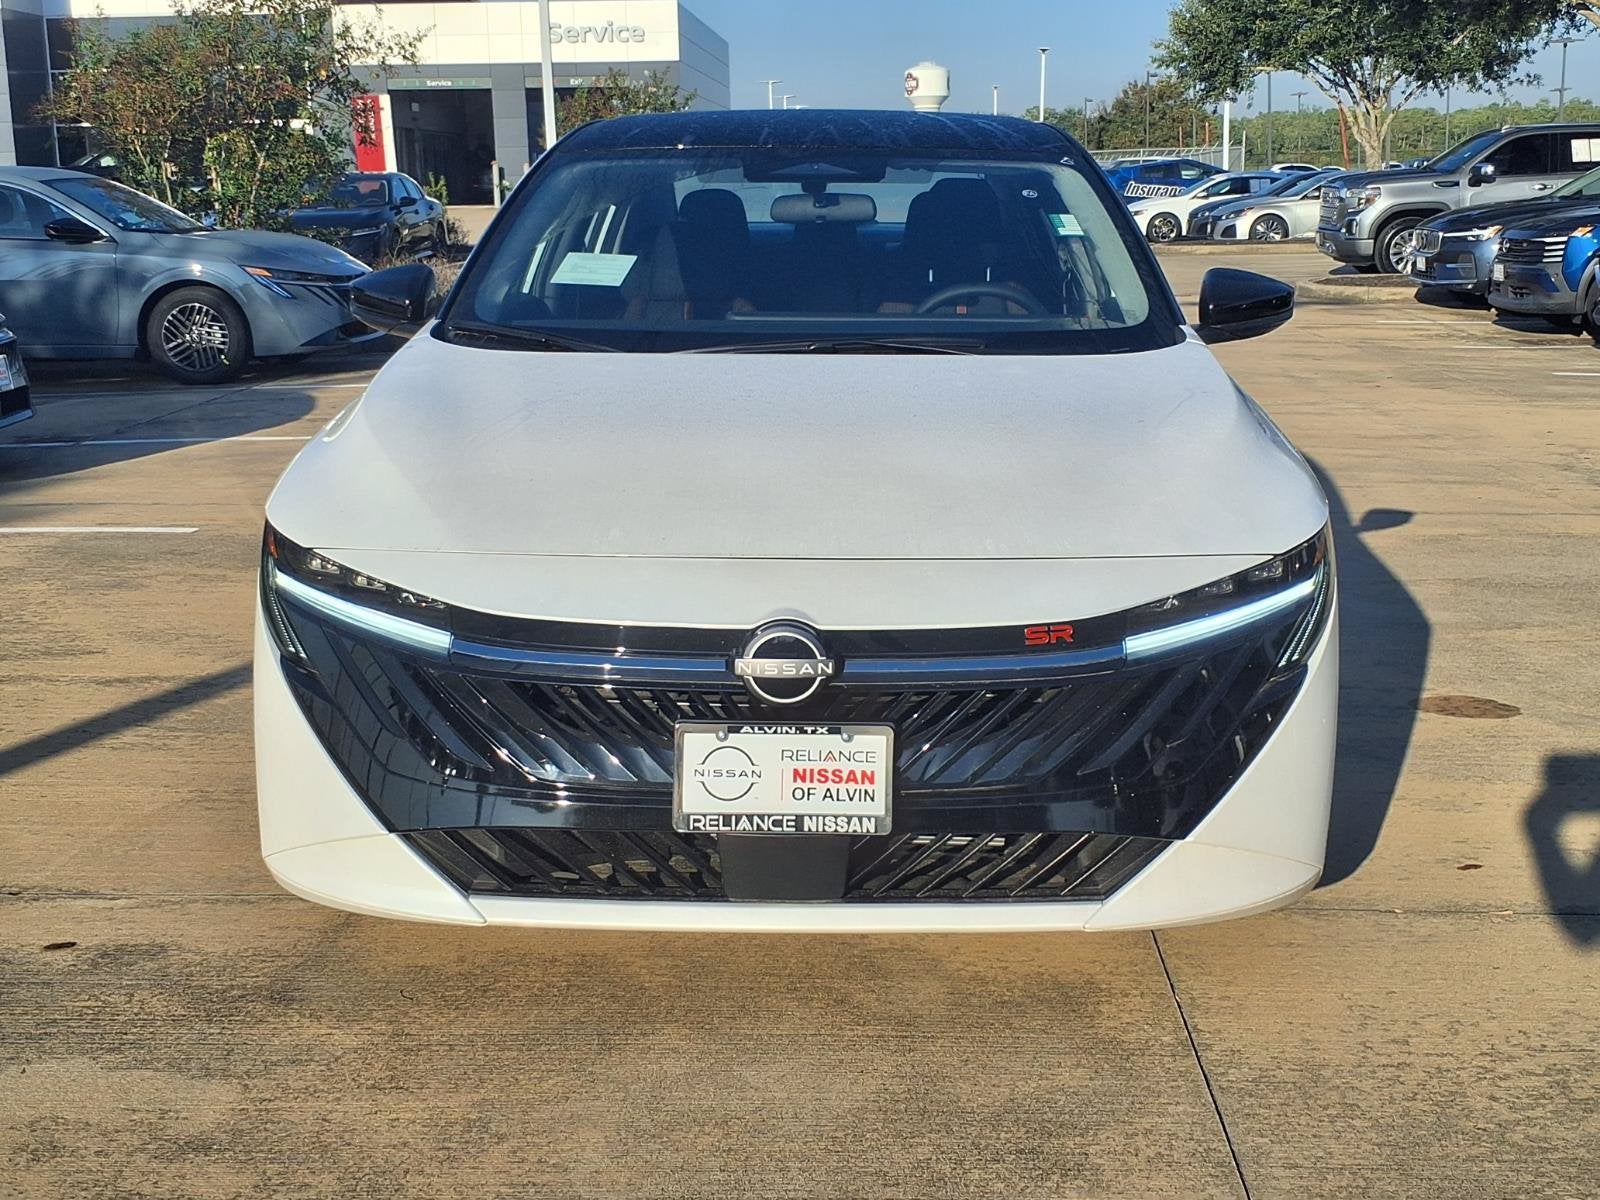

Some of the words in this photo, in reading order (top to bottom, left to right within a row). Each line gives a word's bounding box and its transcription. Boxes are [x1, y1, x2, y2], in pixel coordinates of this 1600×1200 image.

[550, 19, 645, 44] Service
[1024, 624, 1074, 646] SR
[738, 662, 833, 675] NISSAN
[803, 726, 829, 735] TX
[781, 749, 877, 763] RELIANCE
[694, 768, 762, 778] NISSAN
[792, 768, 875, 785] NISSAN
[791, 787, 817, 801] OF
[822, 787, 875, 802] ALVIN
[689, 814, 796, 832] RELIANCE
[803, 815, 876, 833] NISSAN
